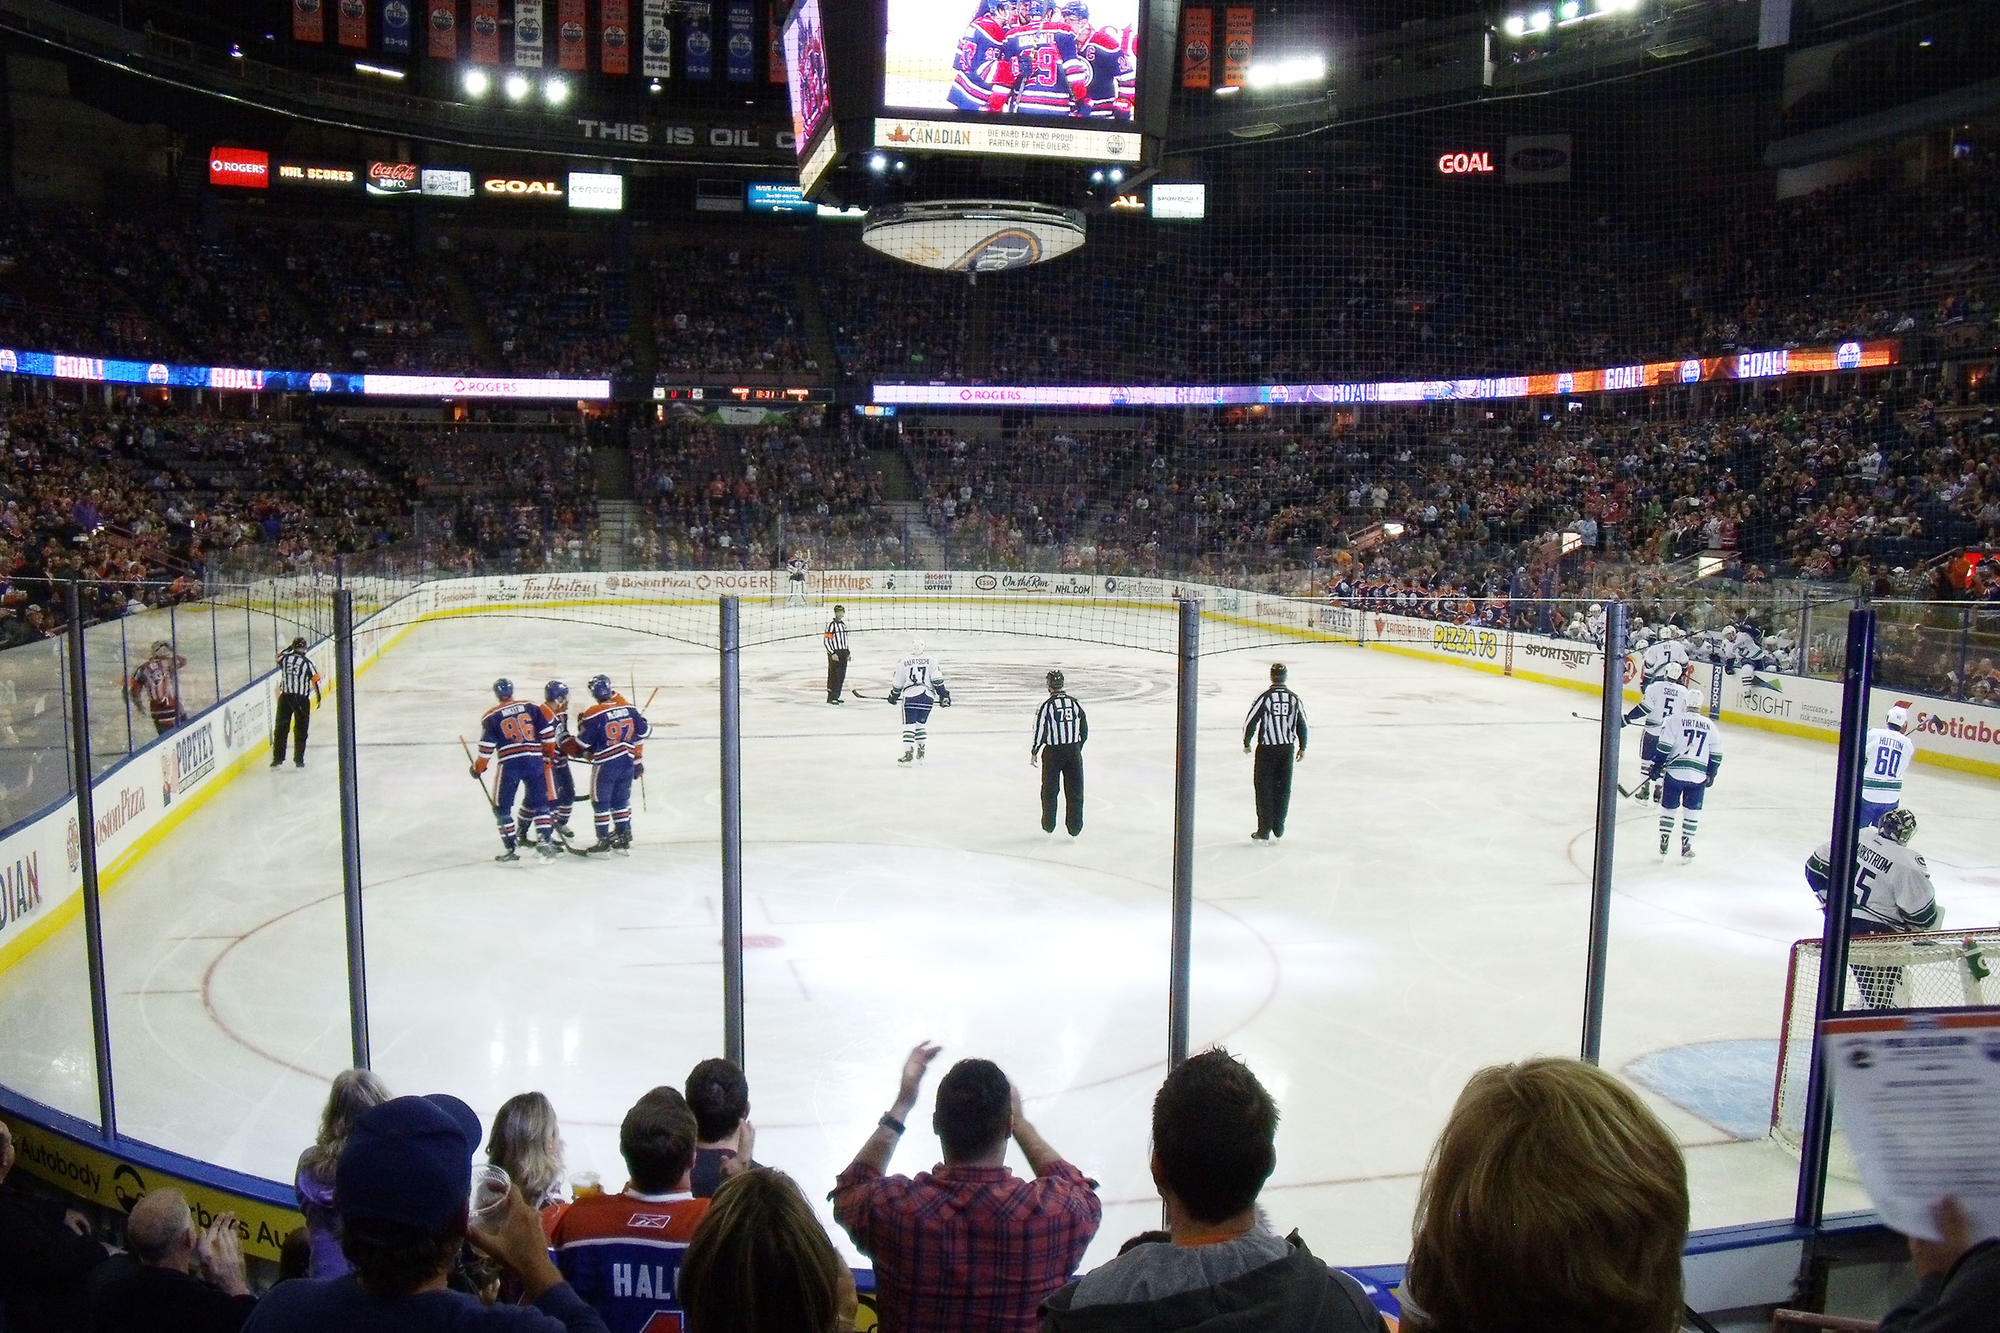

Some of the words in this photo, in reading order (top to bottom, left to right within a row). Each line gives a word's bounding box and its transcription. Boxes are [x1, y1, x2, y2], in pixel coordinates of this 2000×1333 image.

[578, 119, 649, 143] THIS
[666, 126, 695, 145] IS
[709, 128, 760, 147] OIL
[909, 127, 971, 145] CANADIAN
[987, 129, 999, 137] DIE
[1001, 130, 1019, 139] HARD
[1021, 131, 1035, 140] FAN
[1051, 132, 1074, 142] PROUD
[988, 138, 1019, 147] PARTNER
[1032, 141, 1046, 149] THE
[1047, 142, 1070, 151] OILERS
[224, 162, 266, 174] ROGERS
[1438, 151, 1495, 174] GOAL
[279, 165, 305, 178] NHL
[307, 167, 354, 182] SCORES
[484, 179, 563, 196] GOAL
[54, 355, 104, 381] GOAL!
[1738, 350, 1789, 378] GOAL!
[210, 367, 264, 390] GOAL!
[1606, 365, 1645, 390] GOAL!
[468, 382, 518, 393] ROGERS
[974, 390, 1021, 401] ROGERS
[1332, 383, 1379, 403] GOAL!
[1480, 377, 1520, 399] GOAL!
[547, 576, 597, 592] Hortons
[621, 578, 661, 588] Boston
[662, 577, 691, 588] Pizza
[716, 576, 777, 589] ROGERS
[809, 574, 872, 590] DraftKings
[1002, 575, 1015, 587] On
[1016, 575, 1030, 587] the
[1030, 575, 1049, 588] Run
[1055, 584, 1091, 595] NHL.COM
[1117, 580, 1137, 592] Grant
[1319, 607, 1353, 628] POPEYES
[1386, 622, 1417, 638] CANADIAN
[1433, 624, 1477, 656] PIZZA
[1478, 631, 1497, 660] 73
[1525, 643, 1593, 666] SPORTSNET
[286, 663, 300, 675] 23
[909, 666, 927, 684] 47
[1711, 665, 1722, 708] Reebok
[1272, 702, 1289, 715] 98
[1662, 697, 1675, 718] 5
[500, 712, 535, 743] 86
[605, 717, 635, 746] 97
[1681, 718, 1711, 731] VIRTANEN
[176, 722, 214, 779] POPEYES
[1683, 729, 1708, 758] 77
[1879, 736, 1904, 751] HUTTON
[1874, 746, 1902, 778] 60
[95, 804, 122, 847] oston
[120, 786, 146, 826] Pizza
[20, 1137, 101, 1194] Autobody
